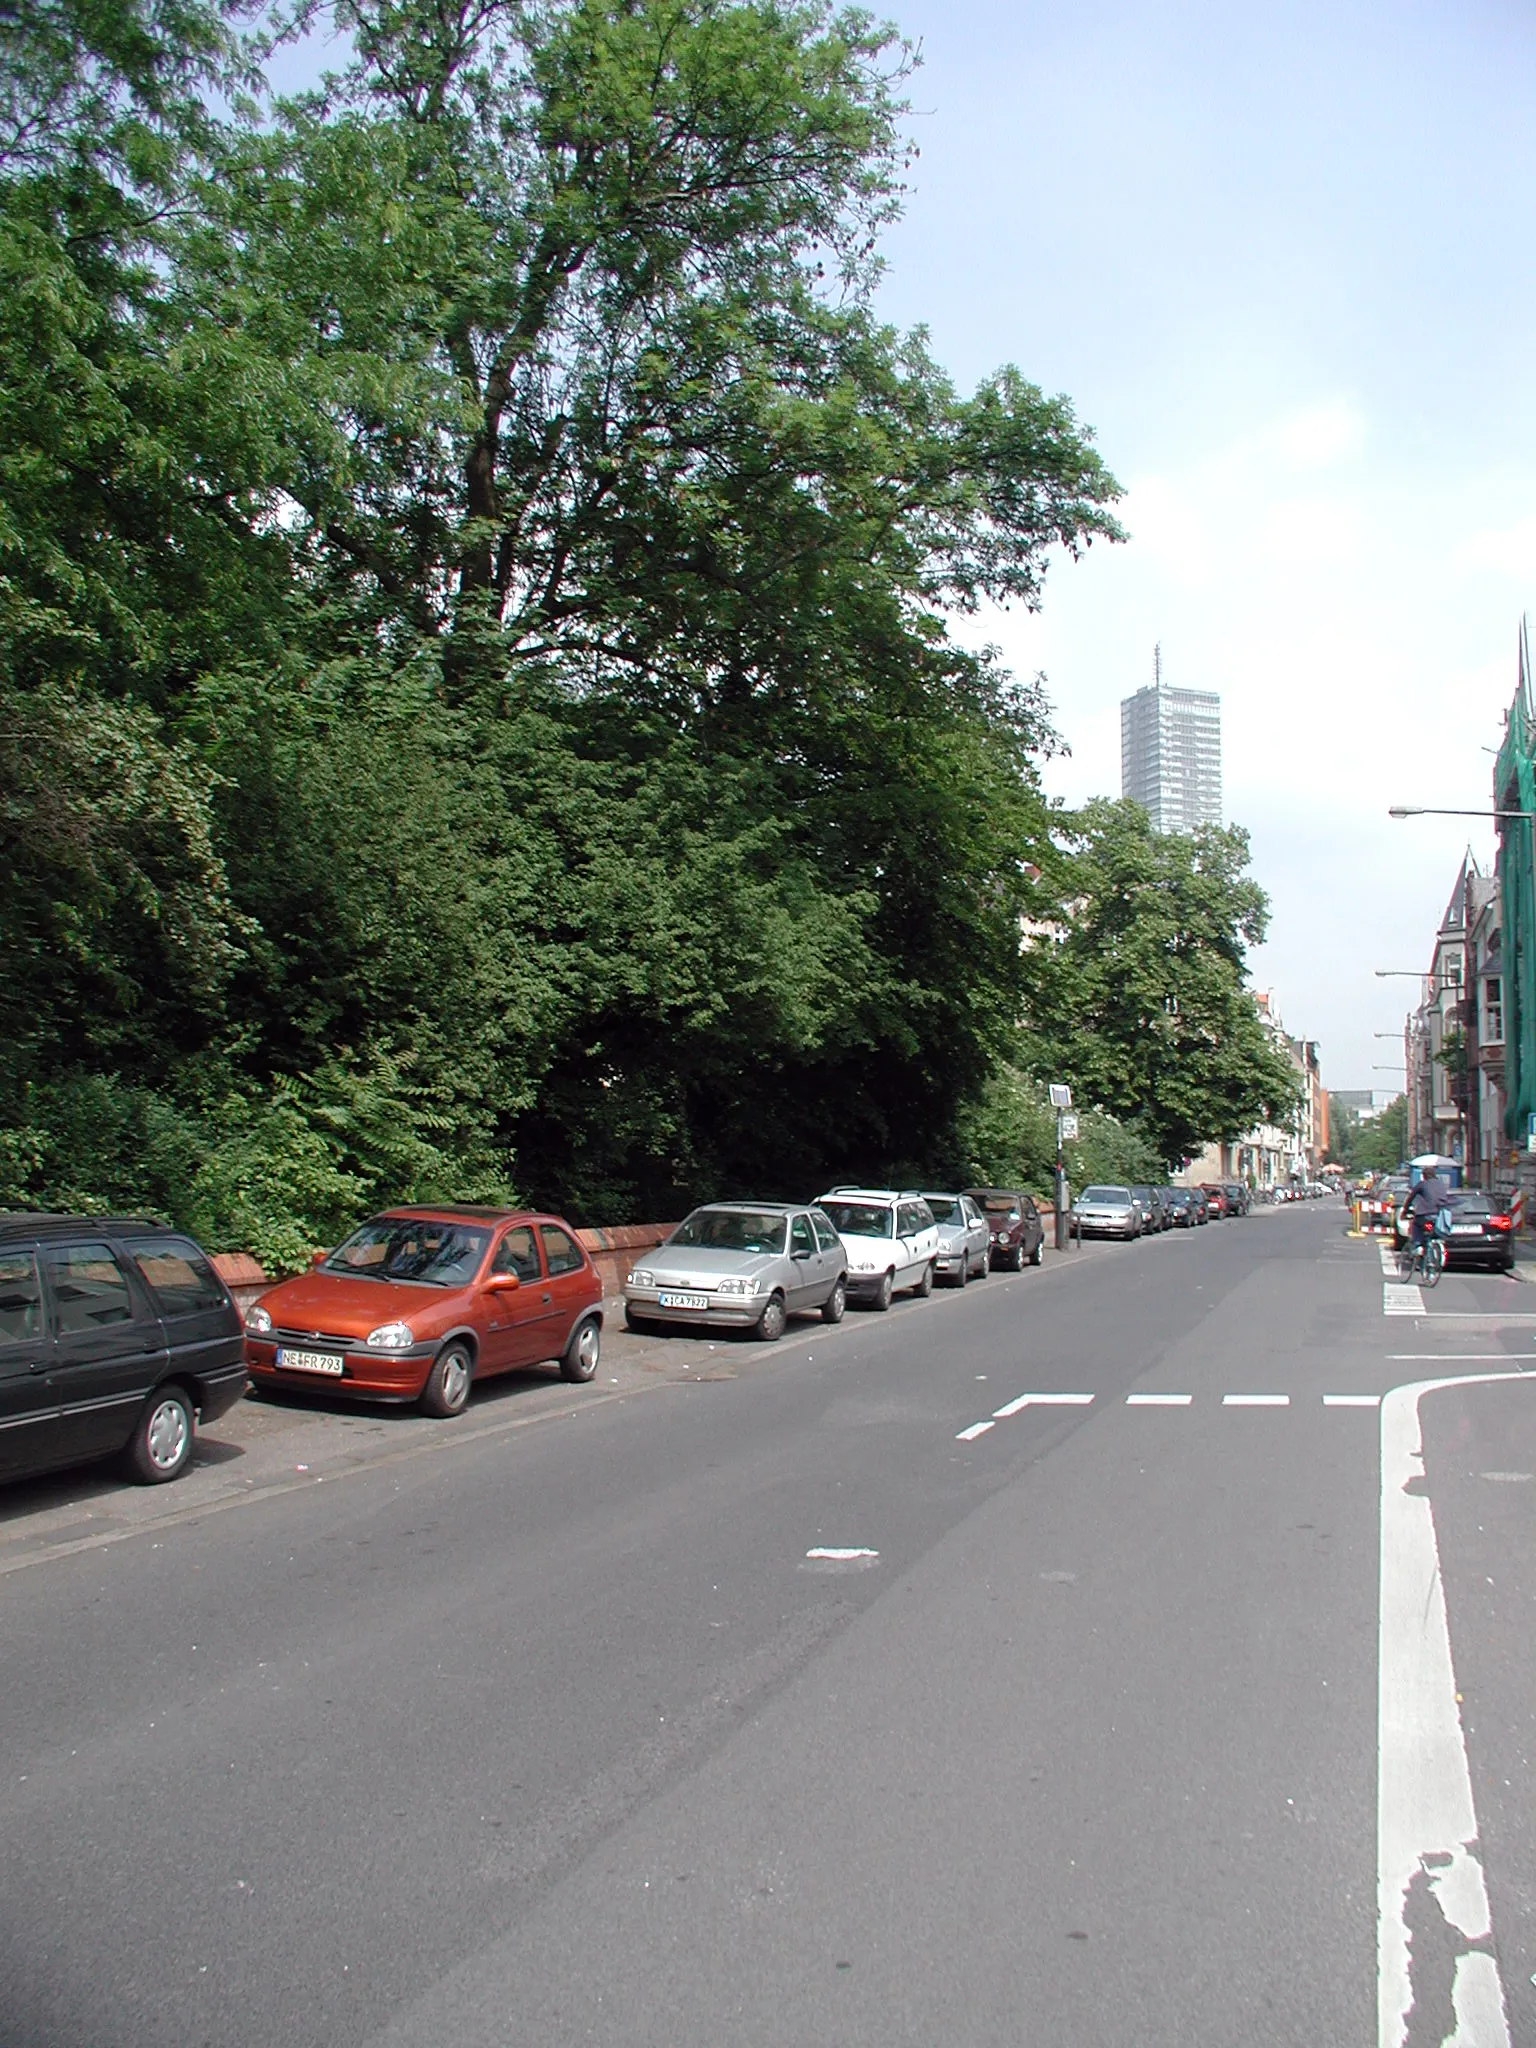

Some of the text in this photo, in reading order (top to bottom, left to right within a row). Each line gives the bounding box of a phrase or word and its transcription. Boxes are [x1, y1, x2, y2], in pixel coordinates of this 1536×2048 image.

[283, 1351, 341, 1371] NE FR 793
